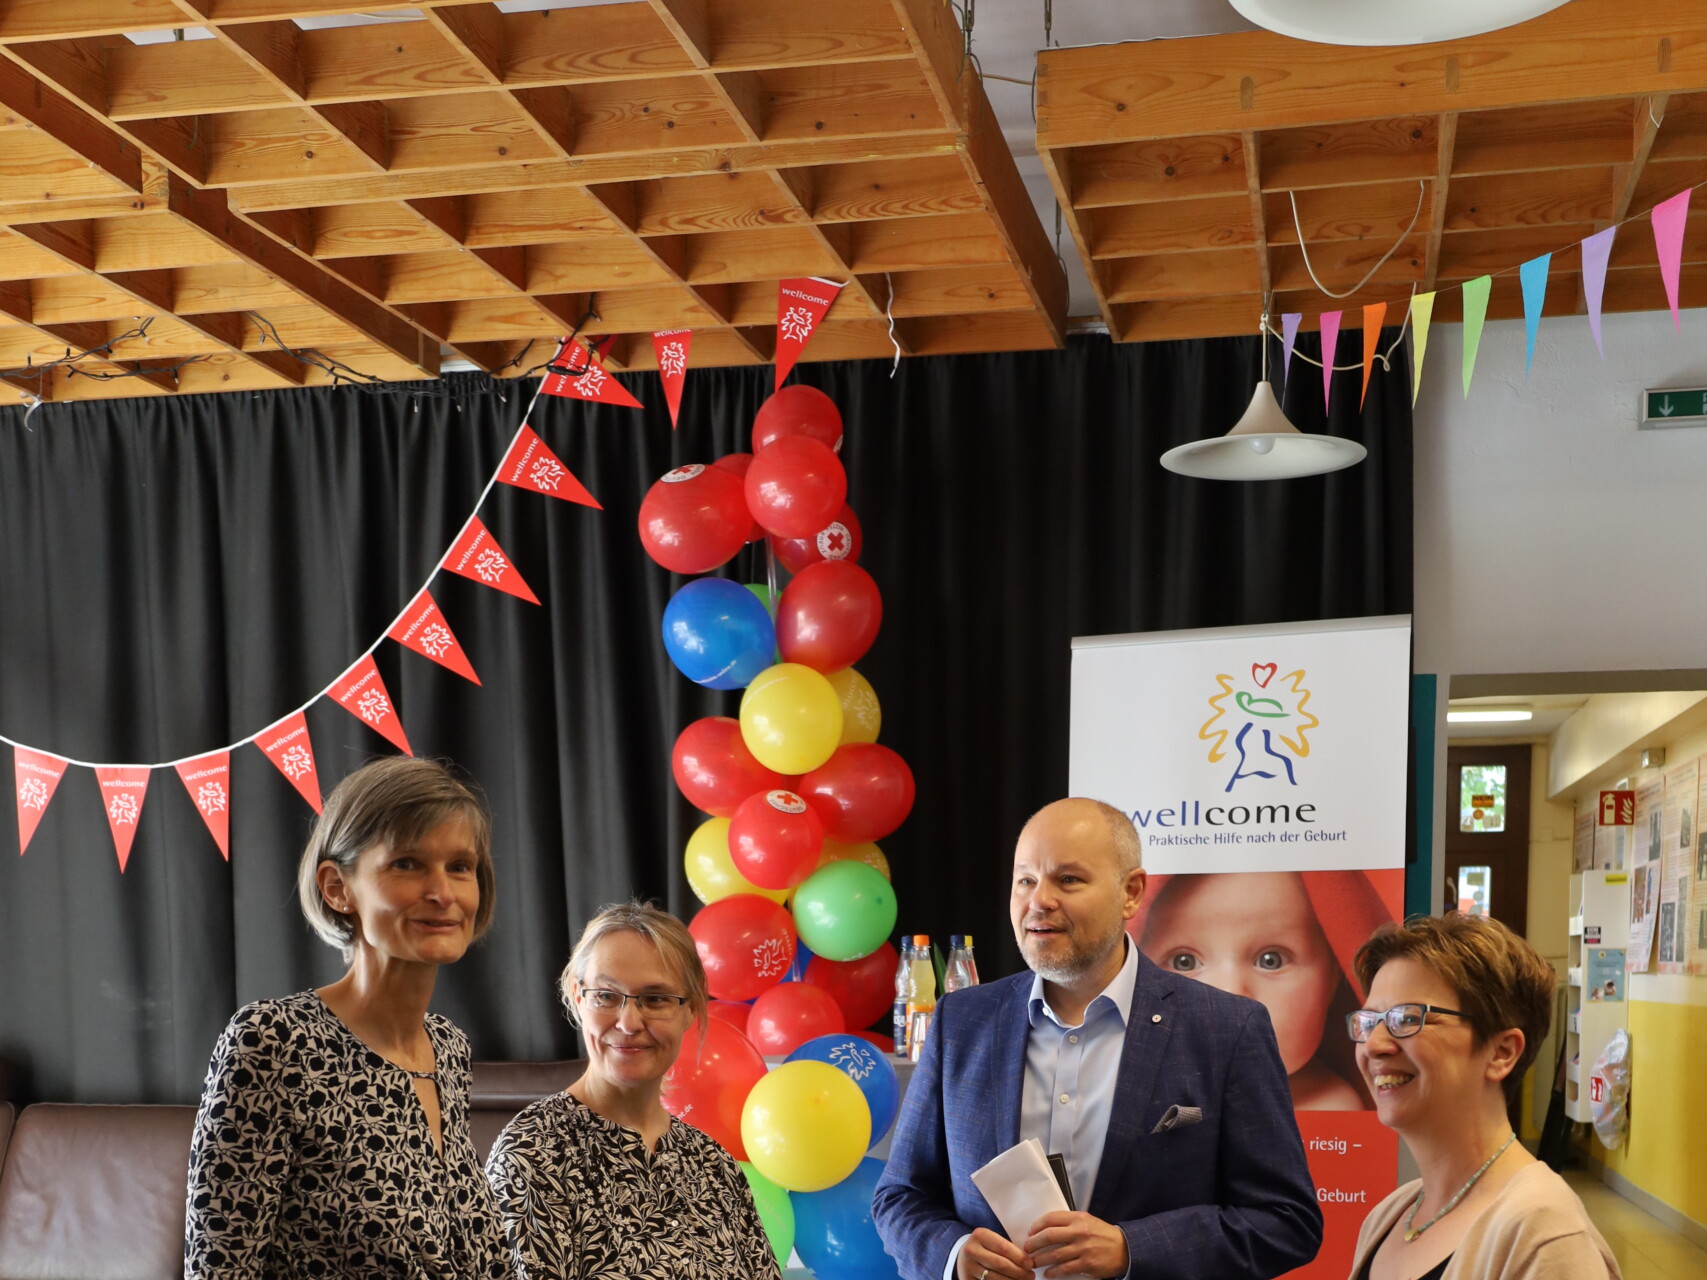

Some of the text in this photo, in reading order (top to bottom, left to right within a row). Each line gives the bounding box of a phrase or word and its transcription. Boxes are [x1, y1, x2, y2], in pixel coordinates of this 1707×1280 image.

[782, 287, 829, 306] wellcome
[510, 438, 539, 482] wellcome
[456, 529, 487, 571] wellcome
[401, 603, 435, 642] wellcome
[340, 669, 377, 703] wellcome
[265, 726, 306, 753] wellcome
[17, 761, 60, 778] wellcome
[185, 765, 228, 782] wellcome
[102, 779, 145, 788] wellcome
[1121, 800, 1316, 828] wellcome
[1149, 828, 1347, 846] Praktische Hilfe nach der Geburt
[1309, 1136, 1347, 1155] riesig
[1316, 1187, 1366, 1203] Geburt
